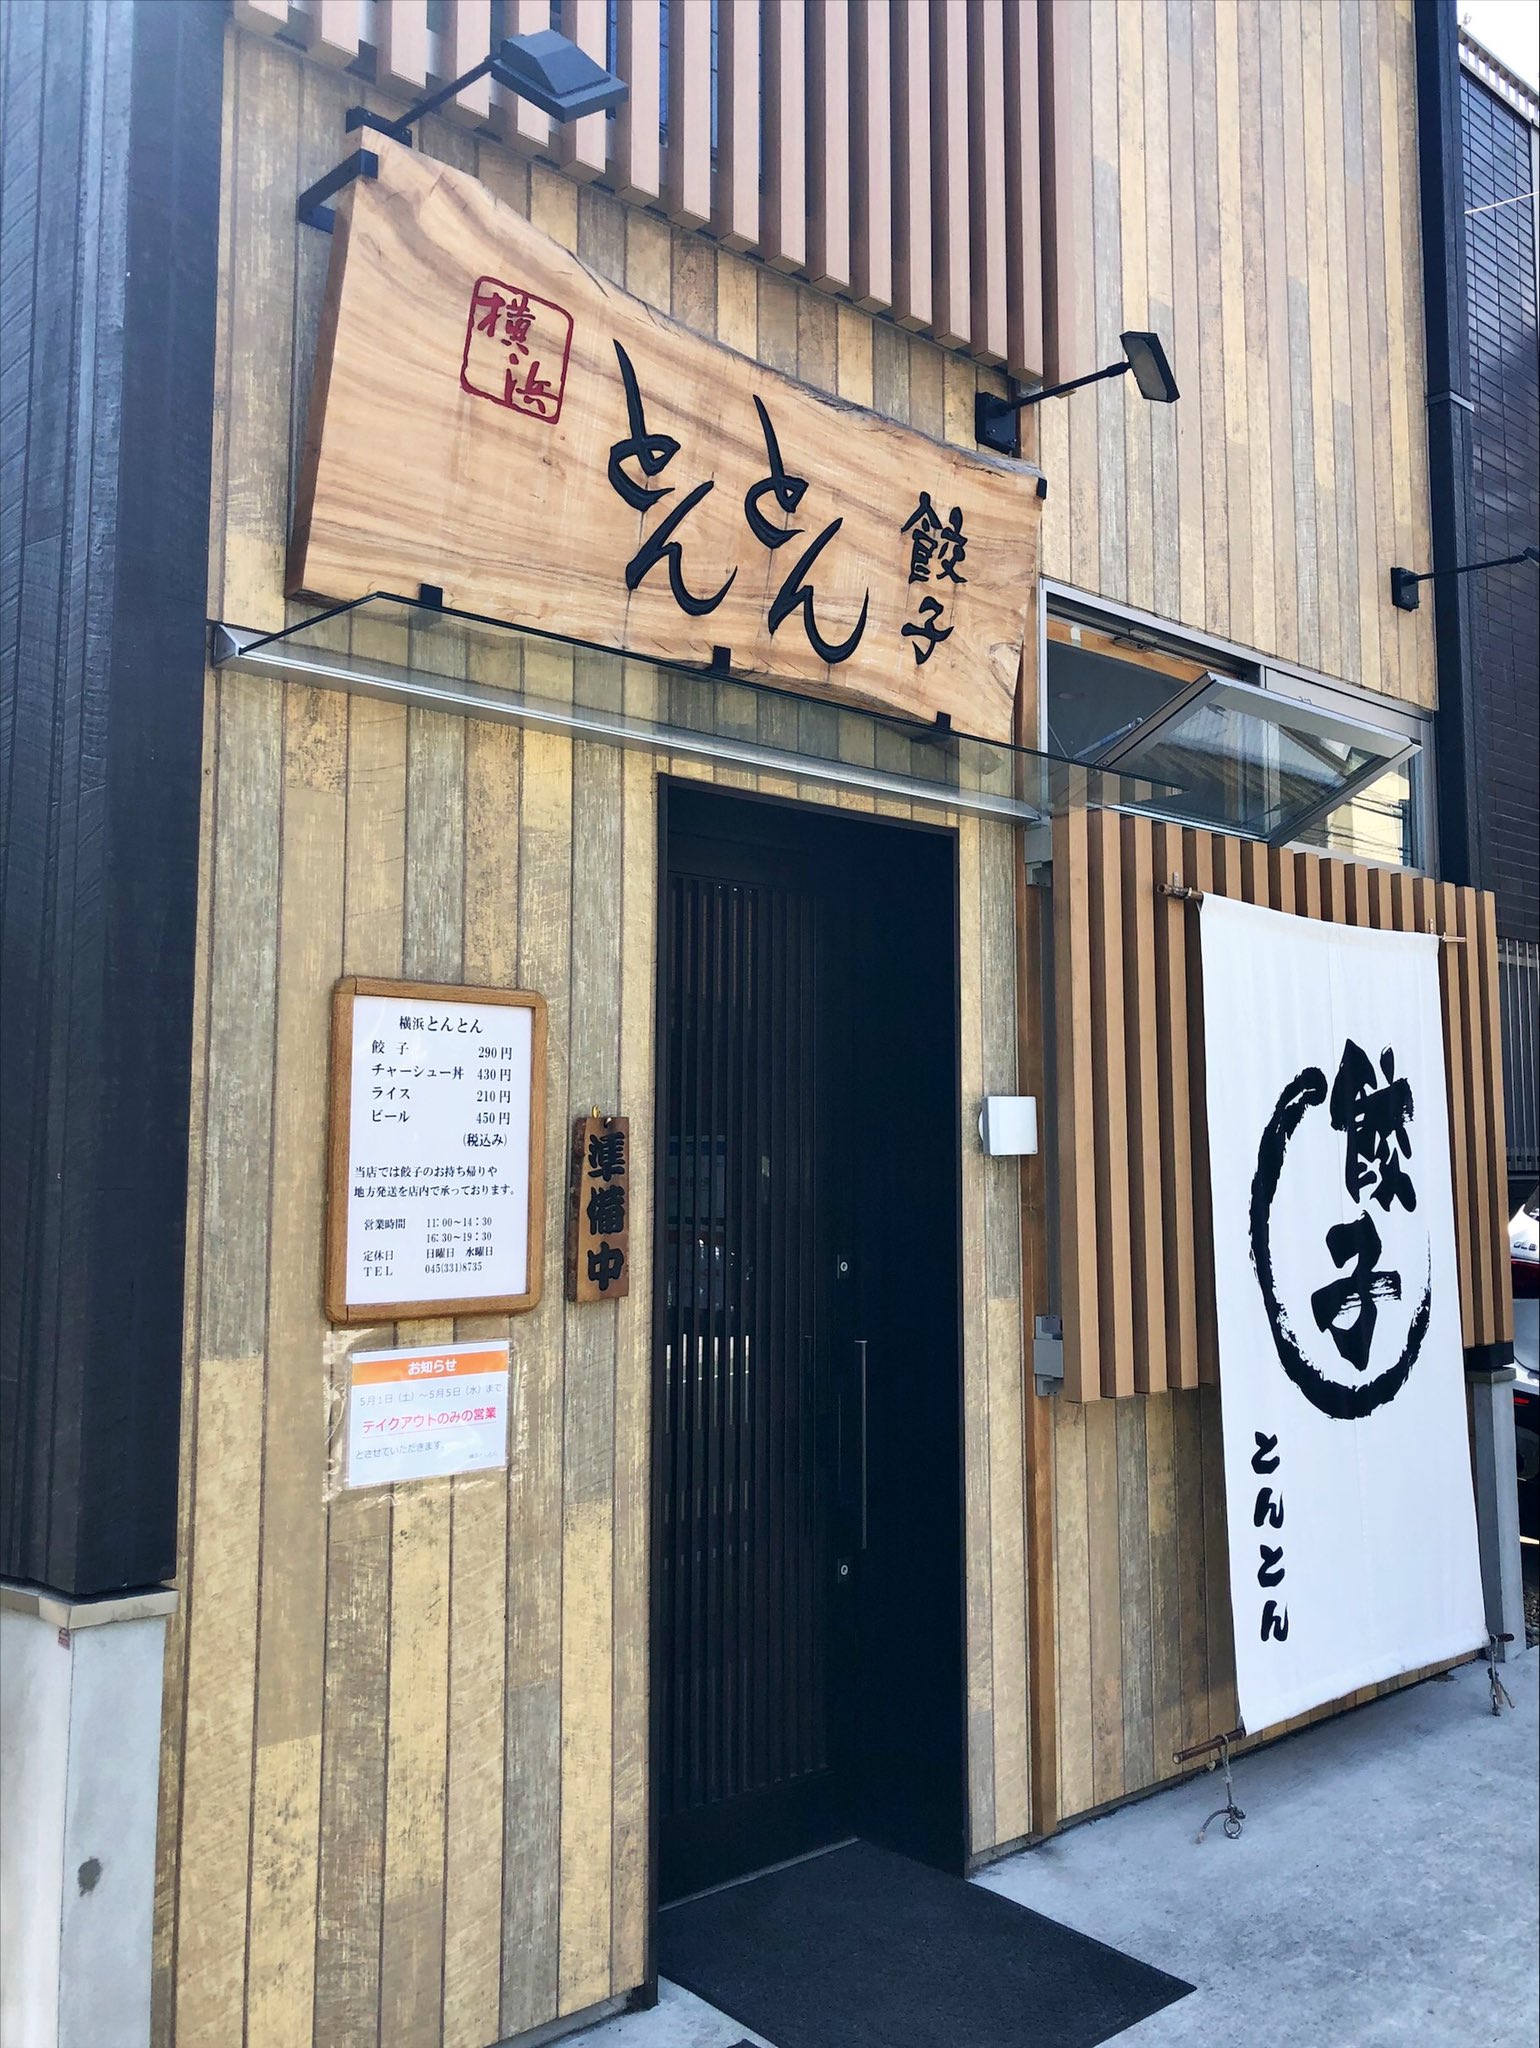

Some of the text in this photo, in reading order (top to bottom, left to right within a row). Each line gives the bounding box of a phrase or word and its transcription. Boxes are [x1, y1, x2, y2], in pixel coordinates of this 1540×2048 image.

[475, 292, 556, 413] 横浜
[901, 491, 968, 665] 餃子
[399, 1016, 484, 1034] 横浜とんとん
[478, 1046, 513, 1060] 290円
[371, 1063, 512, 1082] チャーシュー丼 430円
[371, 1086, 511, 1103] ライス 210円
[371, 1109, 511, 1125] ビール 450円
[355, 1166, 498, 1178] 当店では餃子のお持ち帰りや
[354, 1184, 515, 1198] 地方発送を店内で承っております。
[587, 1131, 625, 1291] 準備中
[1311, 1038, 1417, 1372] 餃子
[364, 1218, 407, 1230] 営業時間
[363, 1246, 493, 1262] 定休日 日曜日 水曜日
[424, 1261, 483, 1274] 045(331)8735
[408, 1359, 457, 1376] お知らせ
[363, 1406, 497, 1434] テイクアウトのみの営業
[1251, 1431, 1289, 1642] とんとん
